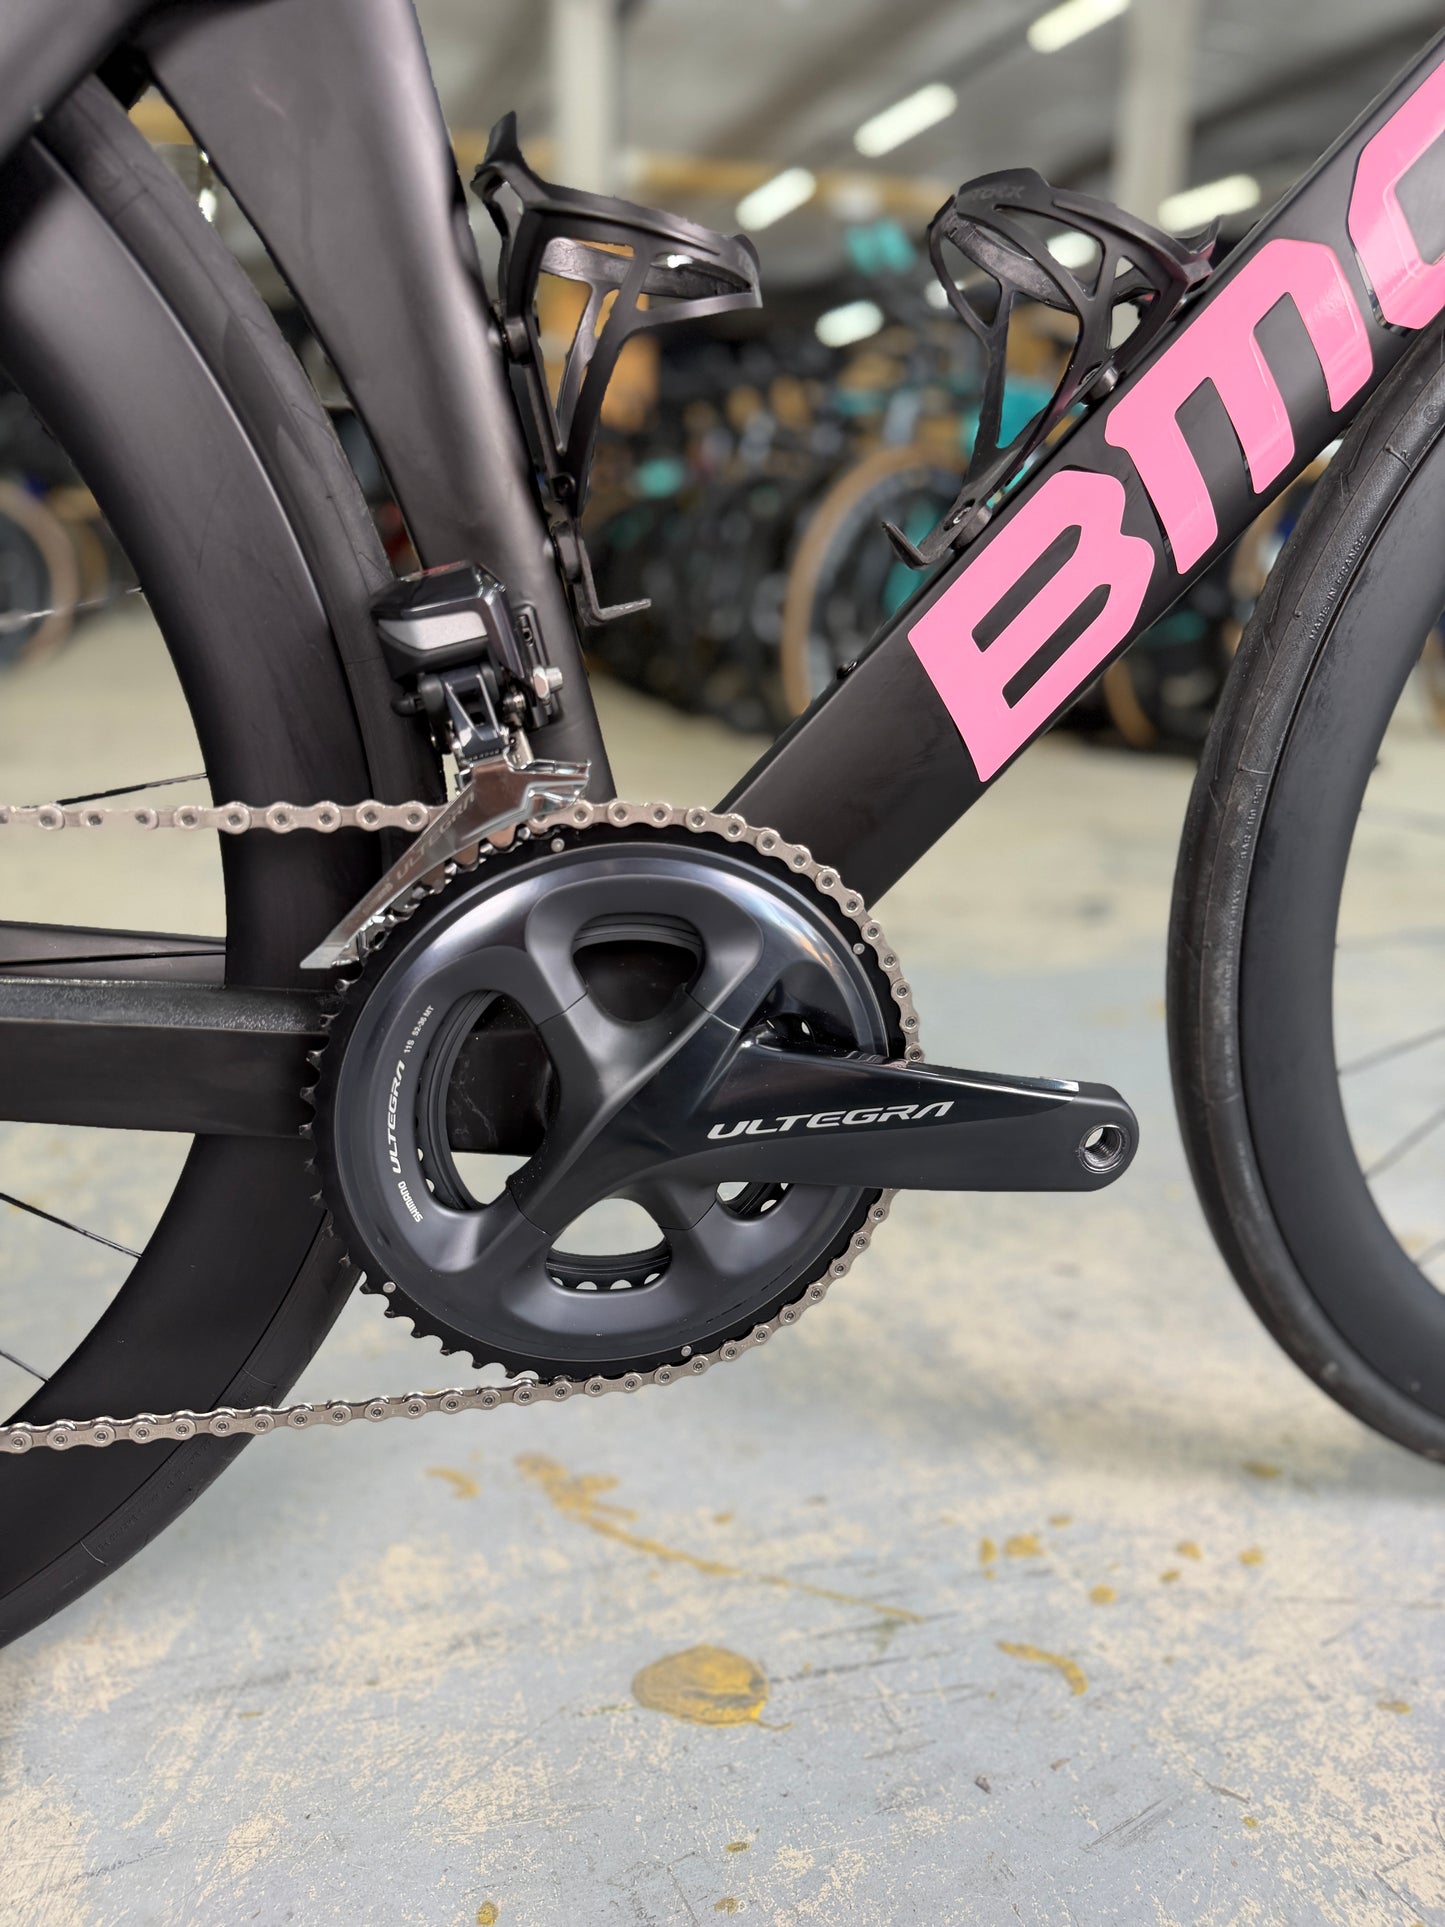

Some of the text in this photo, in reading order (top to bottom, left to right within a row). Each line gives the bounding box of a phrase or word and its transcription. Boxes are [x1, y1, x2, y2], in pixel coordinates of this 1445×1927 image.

[1309, 534, 1367, 640] MADE IN FRANCE
[422, 1004, 434, 1018] MT
[403, 1039, 415, 1054] 11S
[387, 1059, 406, 1174] ULTEGRA
[707, 1100, 955, 1140] ULTEGRA
[397, 1180, 424, 1223] SHIMANO
